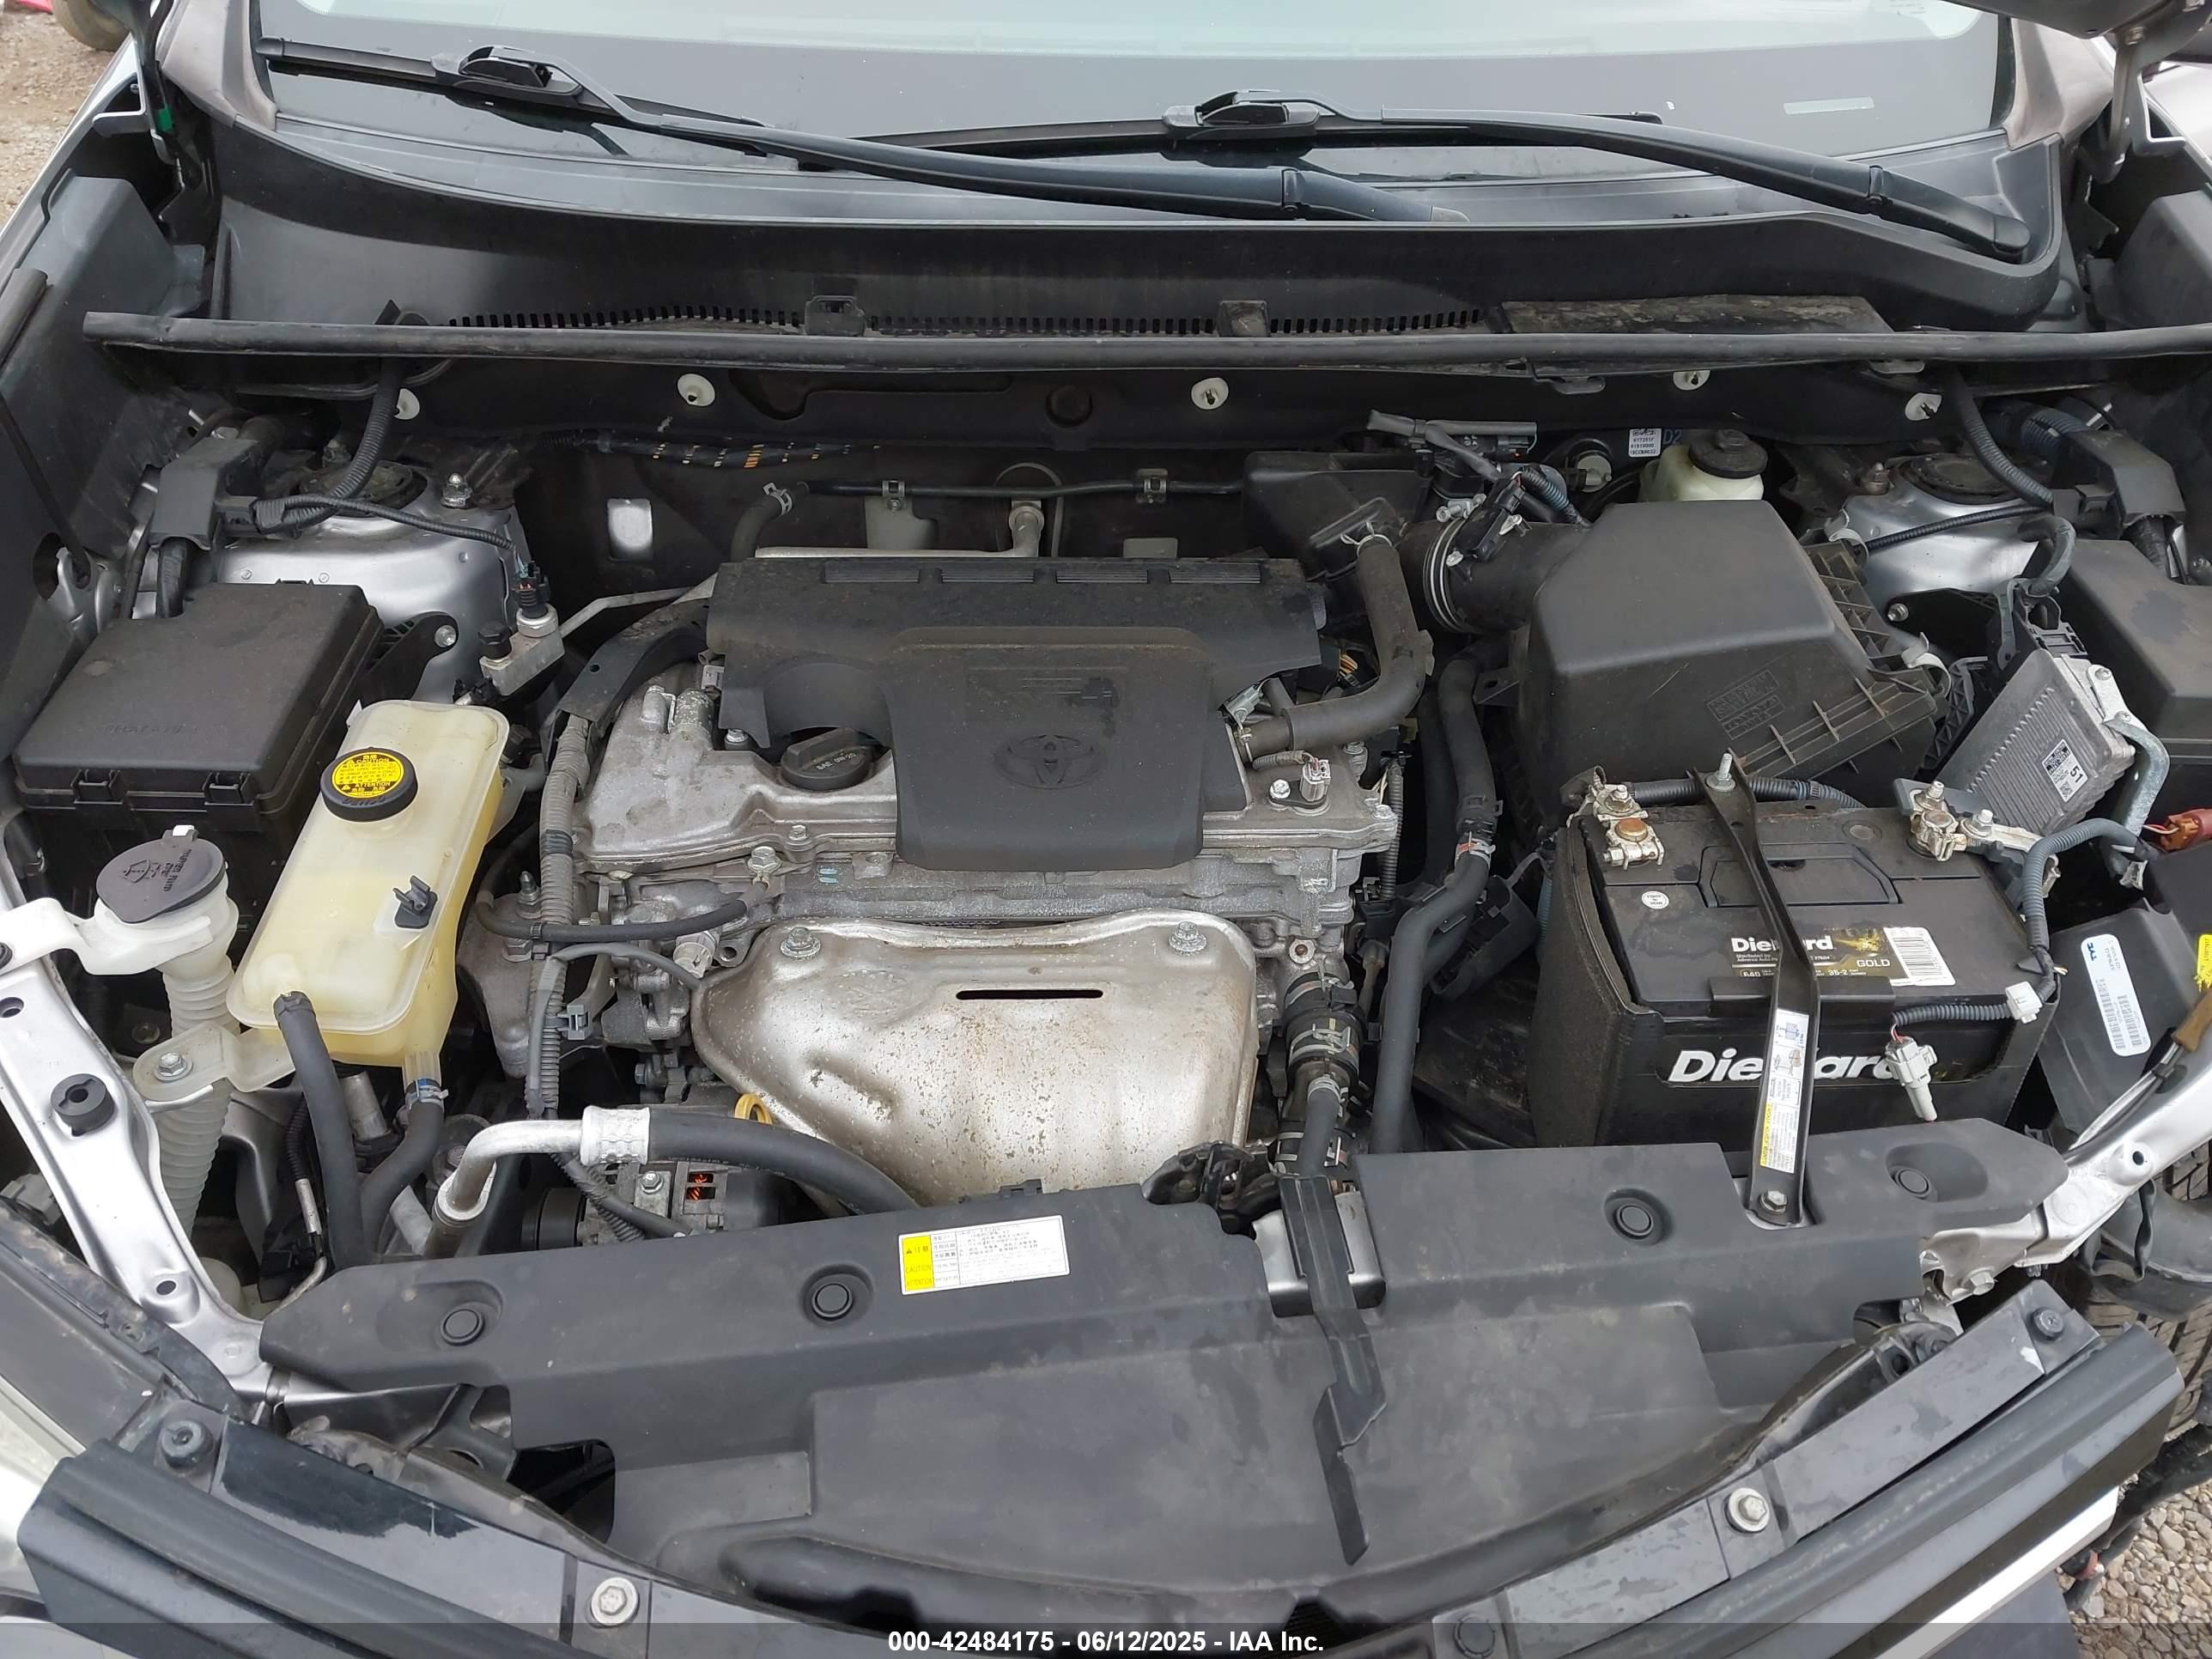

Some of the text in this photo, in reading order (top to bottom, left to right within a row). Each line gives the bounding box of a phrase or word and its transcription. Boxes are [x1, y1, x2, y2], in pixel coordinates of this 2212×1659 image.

[2069, 764, 2085, 784] 51
[2087, 942, 2098, 962] TYC
[1856, 957, 1891, 969] GOLD
[905, 1264, 932, 1273] CAUTION
